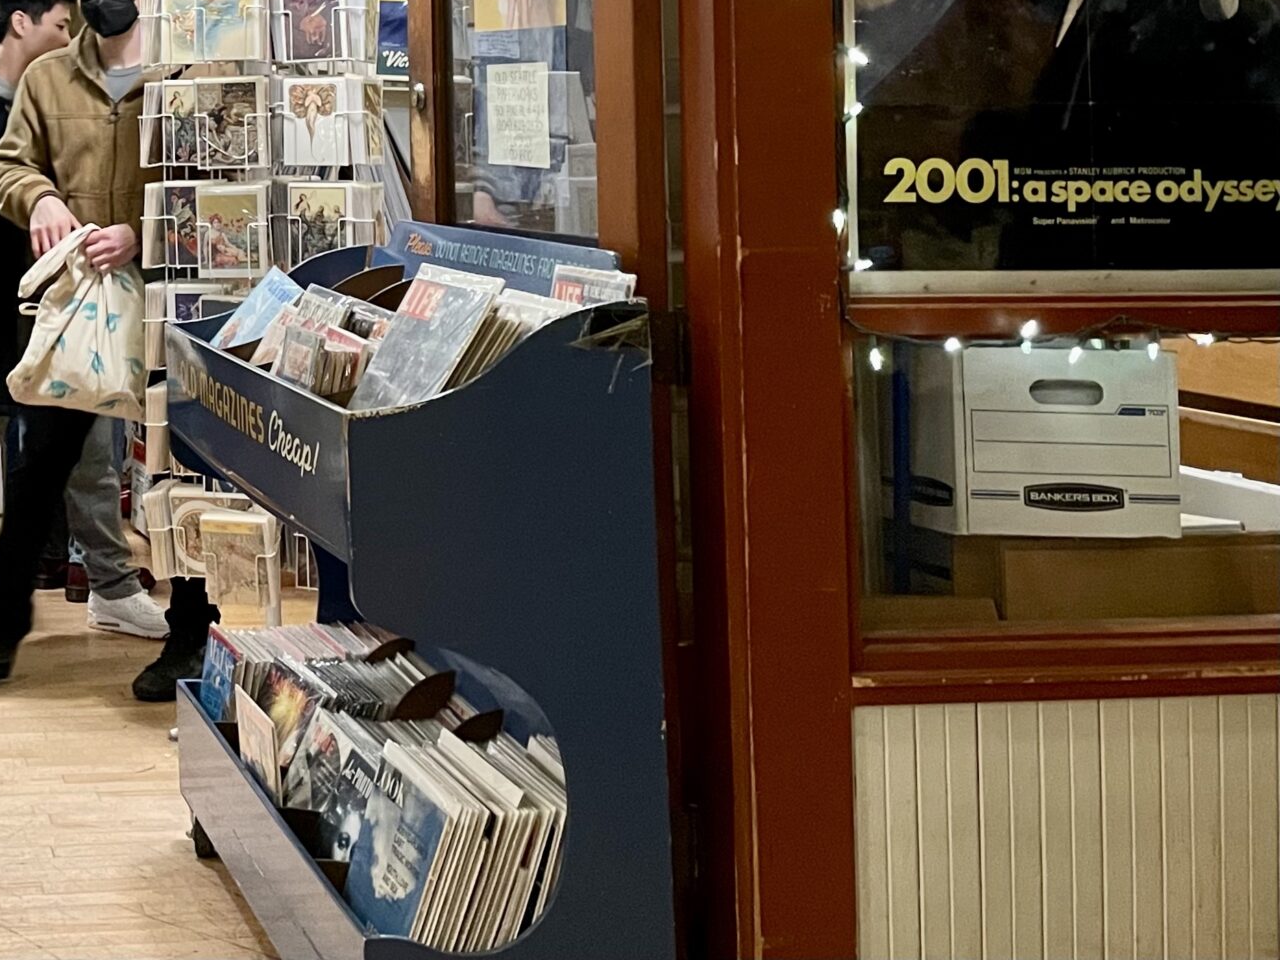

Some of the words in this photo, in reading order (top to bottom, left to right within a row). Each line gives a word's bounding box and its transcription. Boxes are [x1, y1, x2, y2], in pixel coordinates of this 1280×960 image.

[1068, 167, 1100, 176] STANLEY
[1102, 167, 1135, 175] KUBRICK
[1137, 167, 1186, 176] PRODUCTION
[1050, 179, 1151, 212] space
[460, 243, 488, 267] REMOVE
[489, 247, 537, 276] MAGAZINES
[538, 256, 563, 280] FRO
[401, 282, 446, 320] LIFE
[180, 360, 197, 399] OLD
[199, 372, 265, 444] MAGAZINES
[268, 409, 320, 477] Cheap!
[1029, 491, 1090, 502] BANKERS
[1092, 493, 1119, 503] BOX
